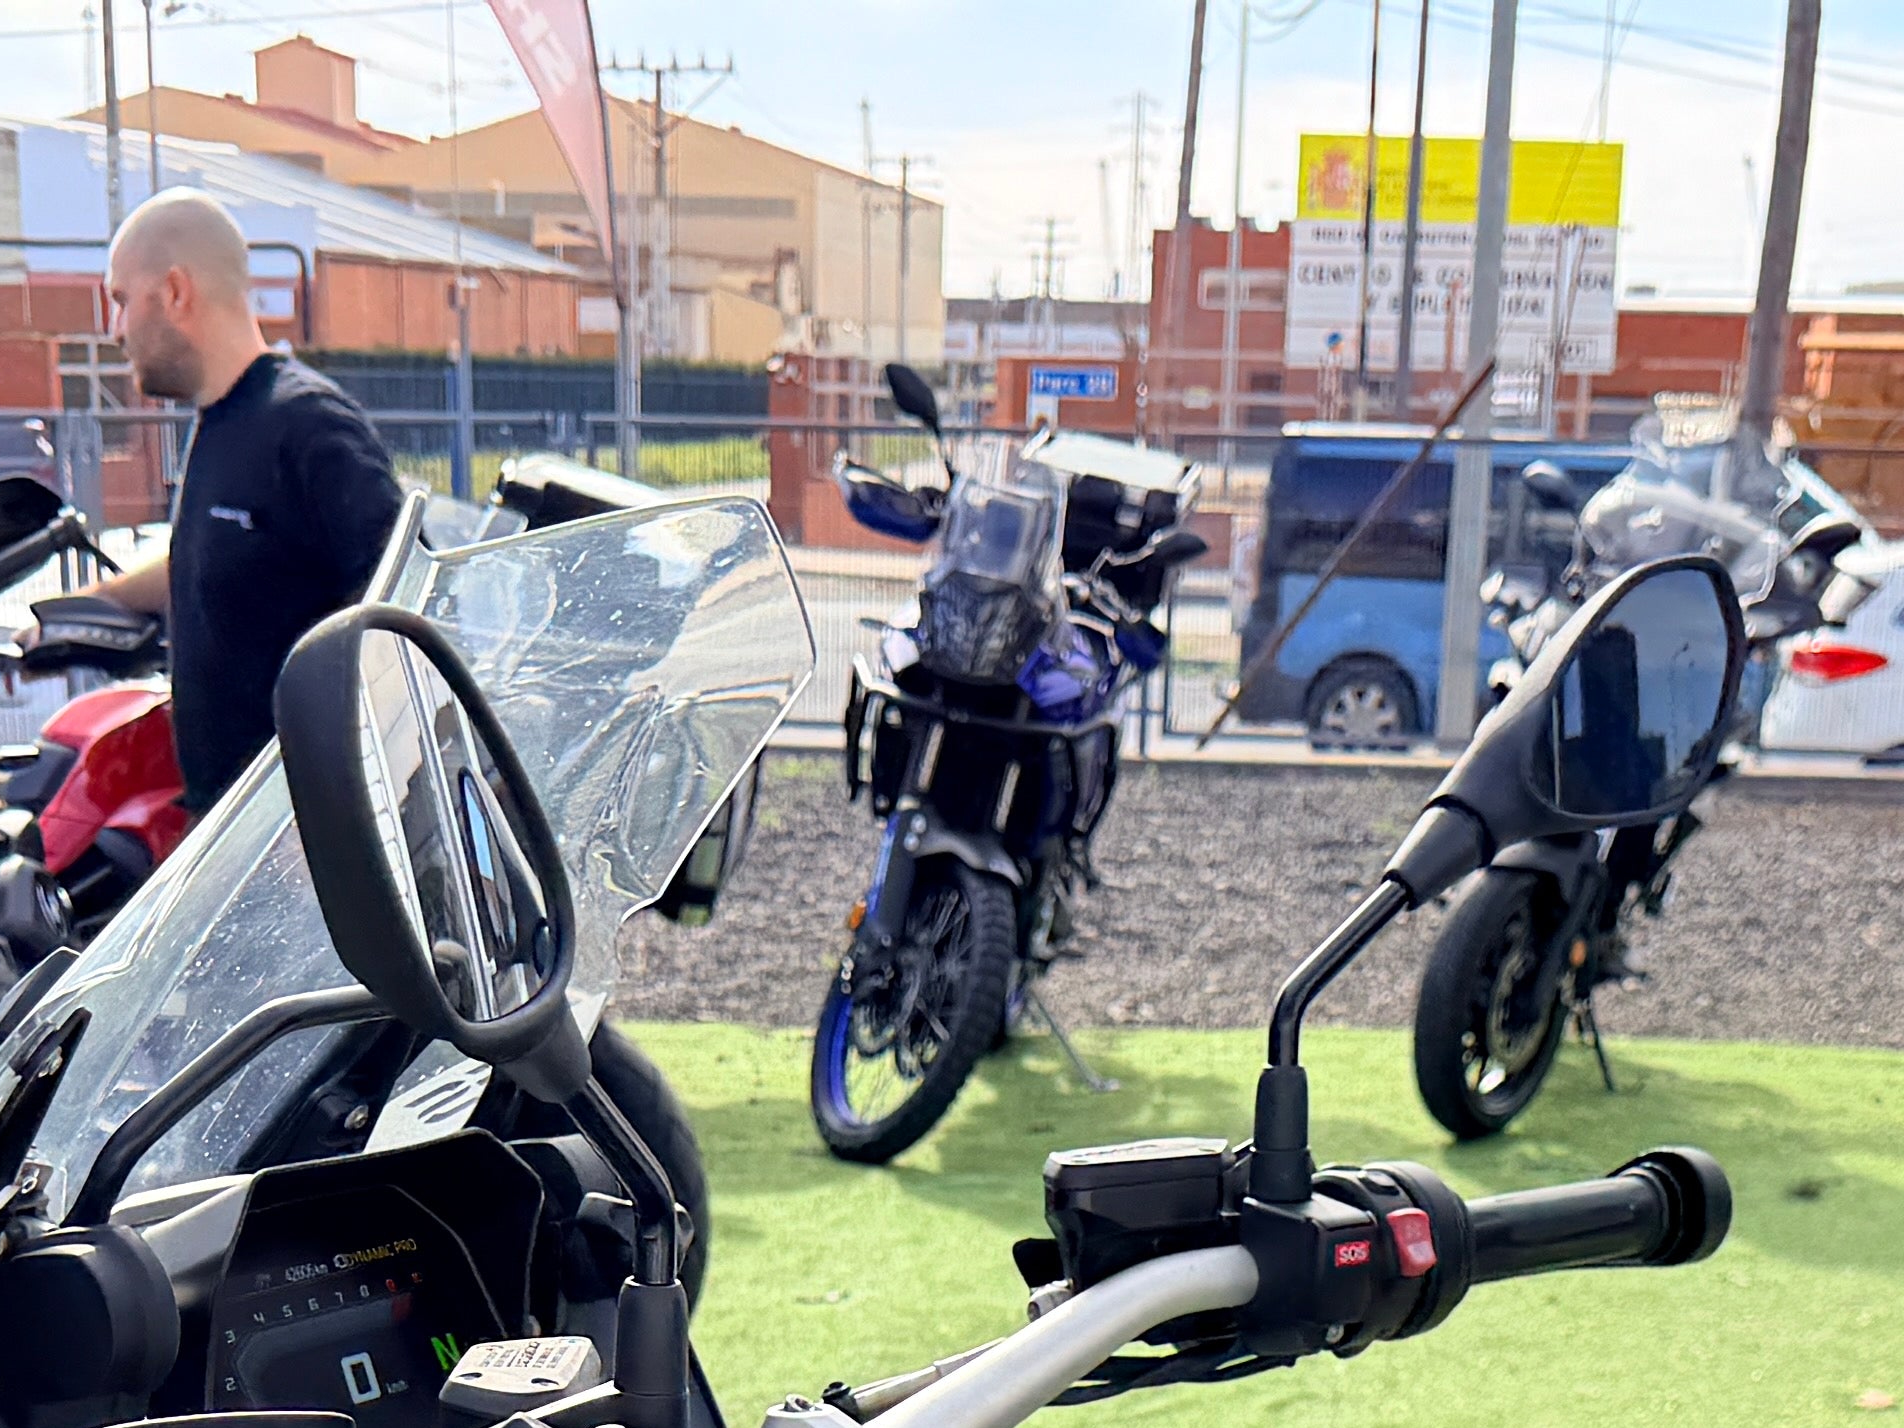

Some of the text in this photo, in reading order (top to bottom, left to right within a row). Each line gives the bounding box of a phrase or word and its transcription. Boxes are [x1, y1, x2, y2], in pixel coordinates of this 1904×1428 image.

[253, 1311, 265, 1324] 4
[282, 1304, 293, 1317] 5
[308, 1298, 319, 1311] 6
[335, 1291, 344, 1303] 7
[225, 1329, 236, 1344] 3
[431, 1332, 460, 1371] N
[225, 1377, 236, 1391] 2
[341, 1352, 382, 1405] 0
